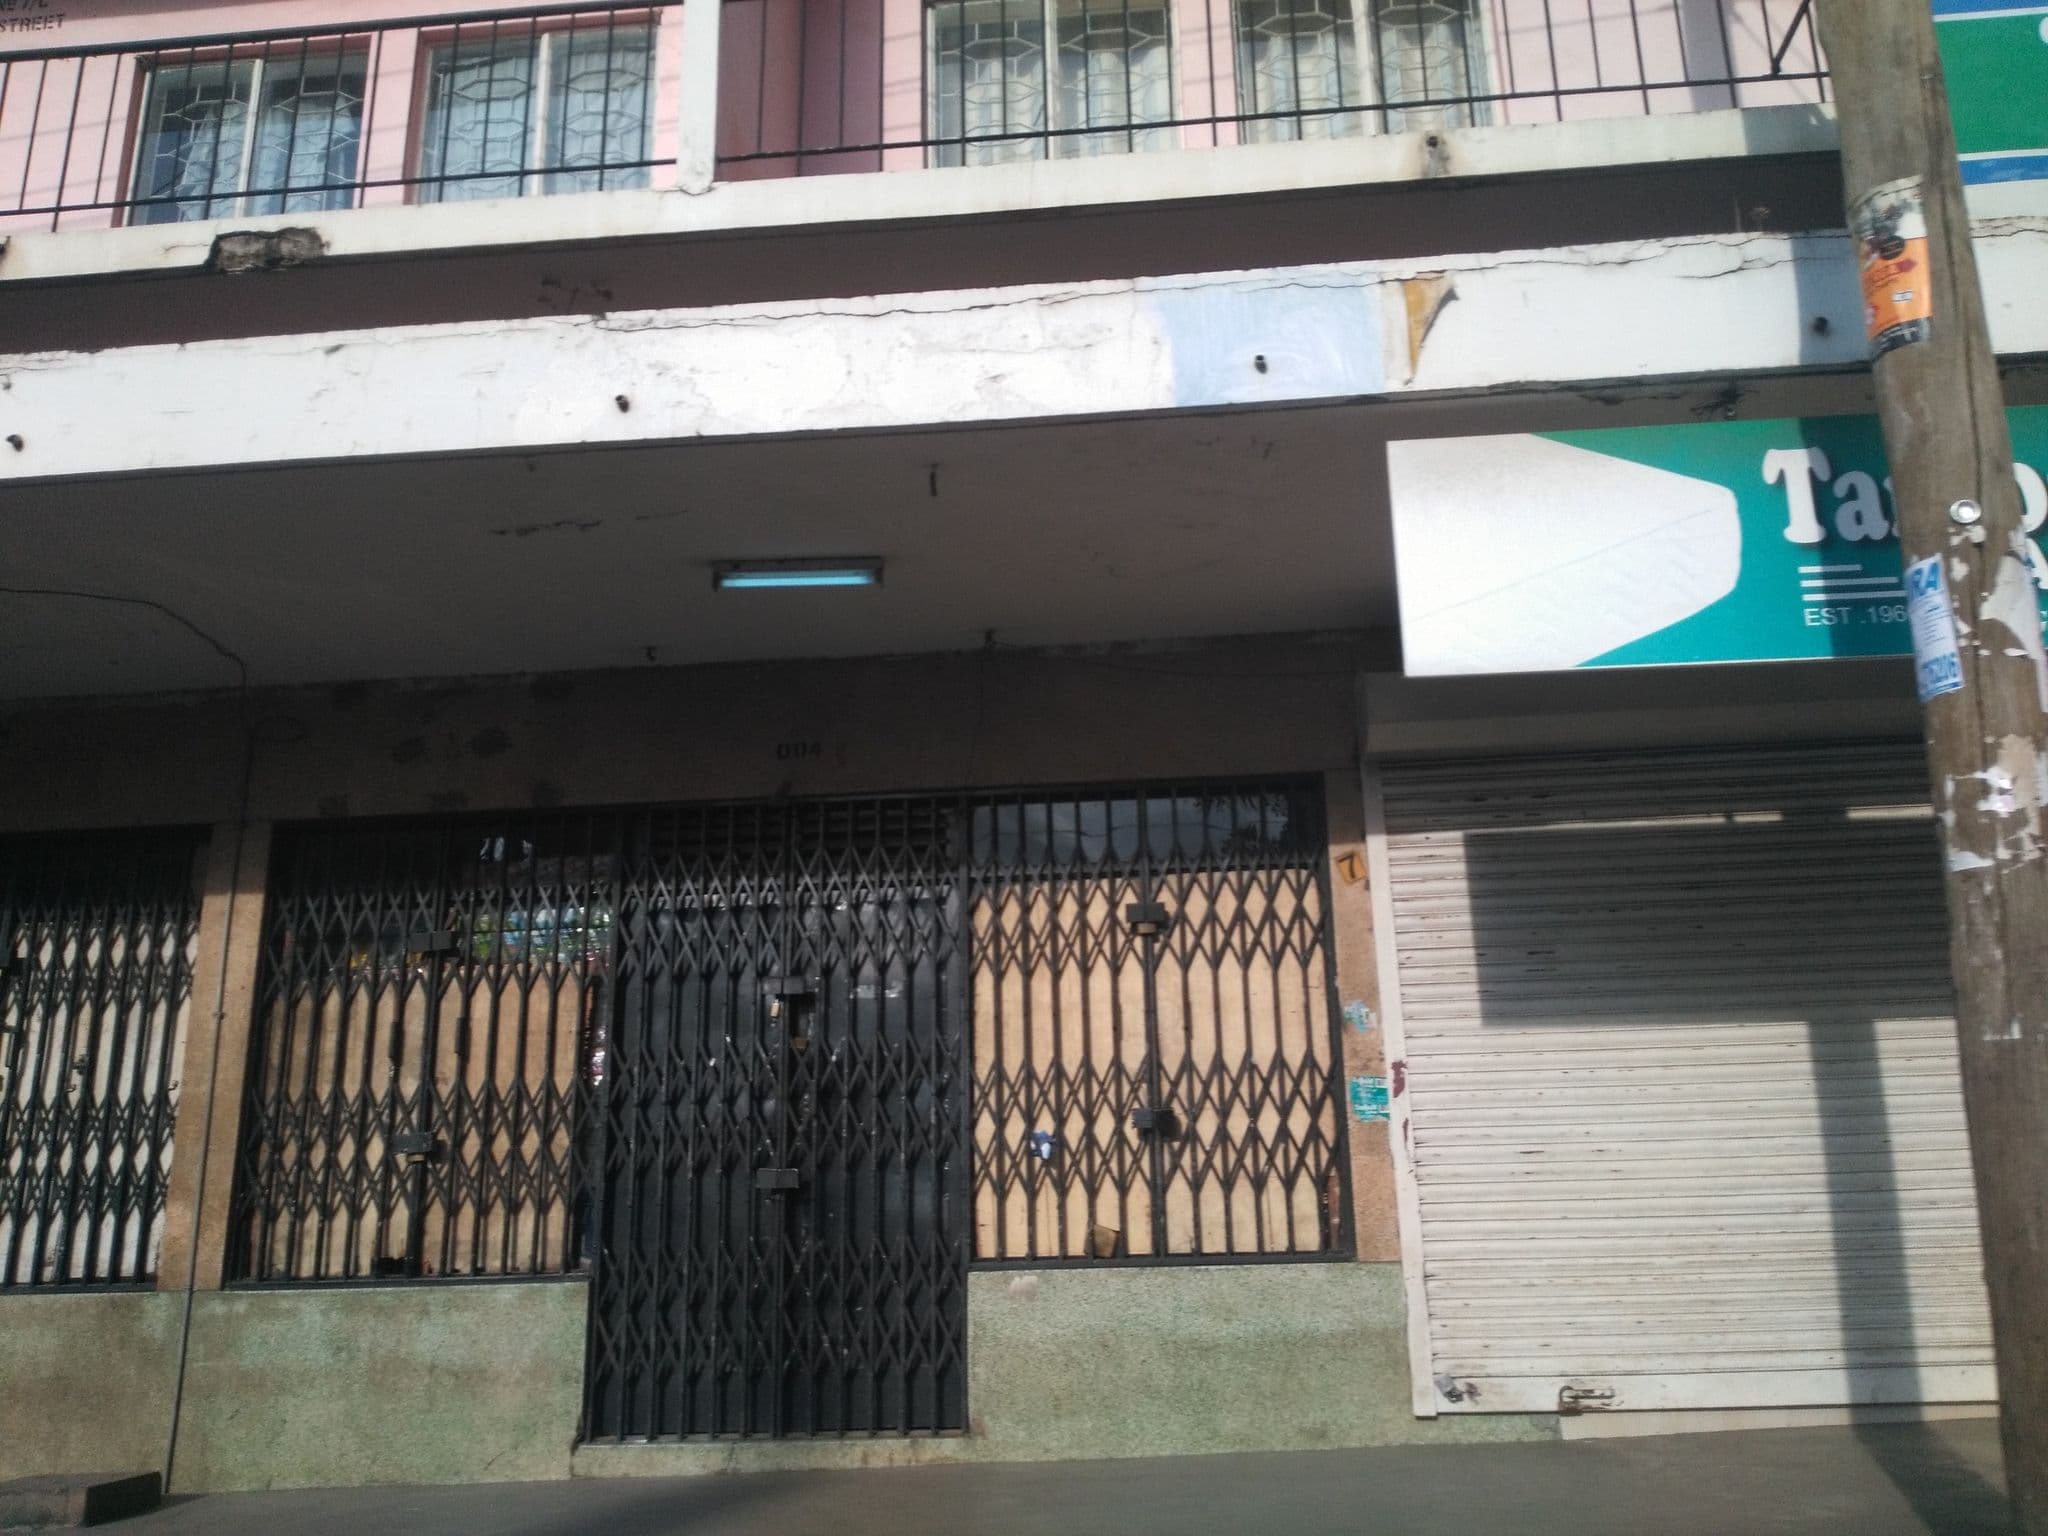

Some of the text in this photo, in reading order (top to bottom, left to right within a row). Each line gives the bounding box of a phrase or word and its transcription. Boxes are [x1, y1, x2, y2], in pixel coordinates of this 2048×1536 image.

[0, 12, 65, 33] STREET
[1803, 606, 1851, 627] EST
[1860, 604, 1909, 624] .196
